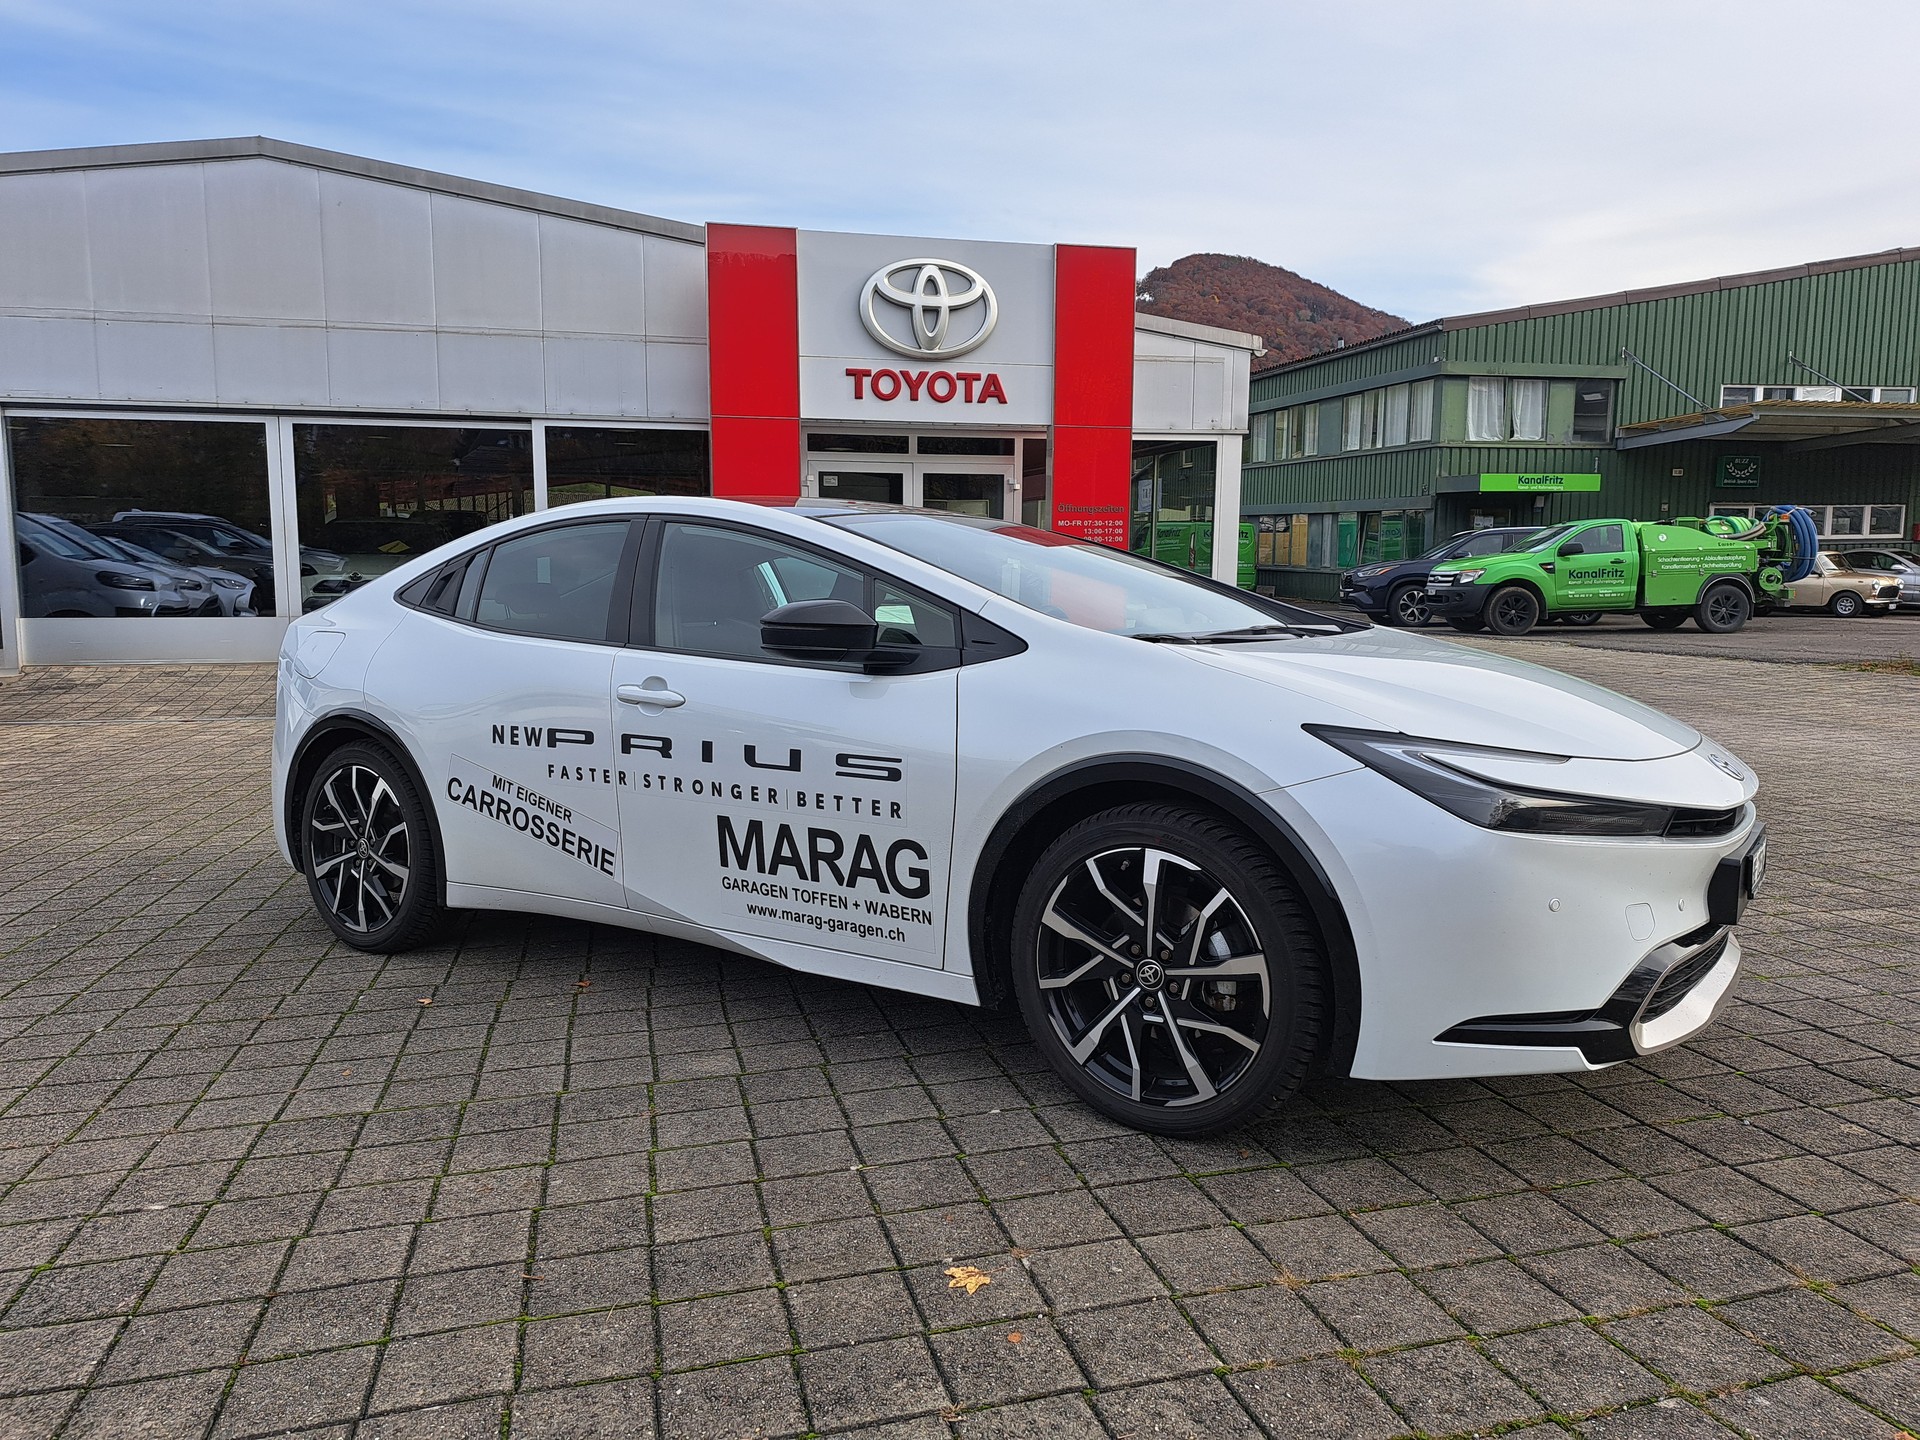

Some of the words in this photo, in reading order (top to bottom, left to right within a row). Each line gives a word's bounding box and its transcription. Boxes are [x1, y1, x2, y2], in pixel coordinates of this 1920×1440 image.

[846, 368, 1008, 404] TOYOTA
[1517, 475, 1564, 485] KanalFritz
[1057, 503, 1125, 515] Öffnungszeiten
[1568, 567, 1625, 579] KanalFritz
[492, 724, 543, 748] NEW
[547, 728, 902, 782] PRIUS
[492, 775, 513, 795] MIT
[516, 787, 572, 823] EIGENER
[548, 764, 627, 786] FASTER
[643, 774, 778, 804] STRONGER
[797, 791, 902, 819] BETTER
[447, 777, 615, 876] CARROSSERIE
[716, 815, 931, 899] MARAG
[722, 877, 788, 900] GARAGEN
[792, 888, 848, 911] TOFFEN
[852, 901, 861, 910] +
[864, 900, 932, 926] WABERN
[747, 904, 906, 942] www.marag-garagen.ch
